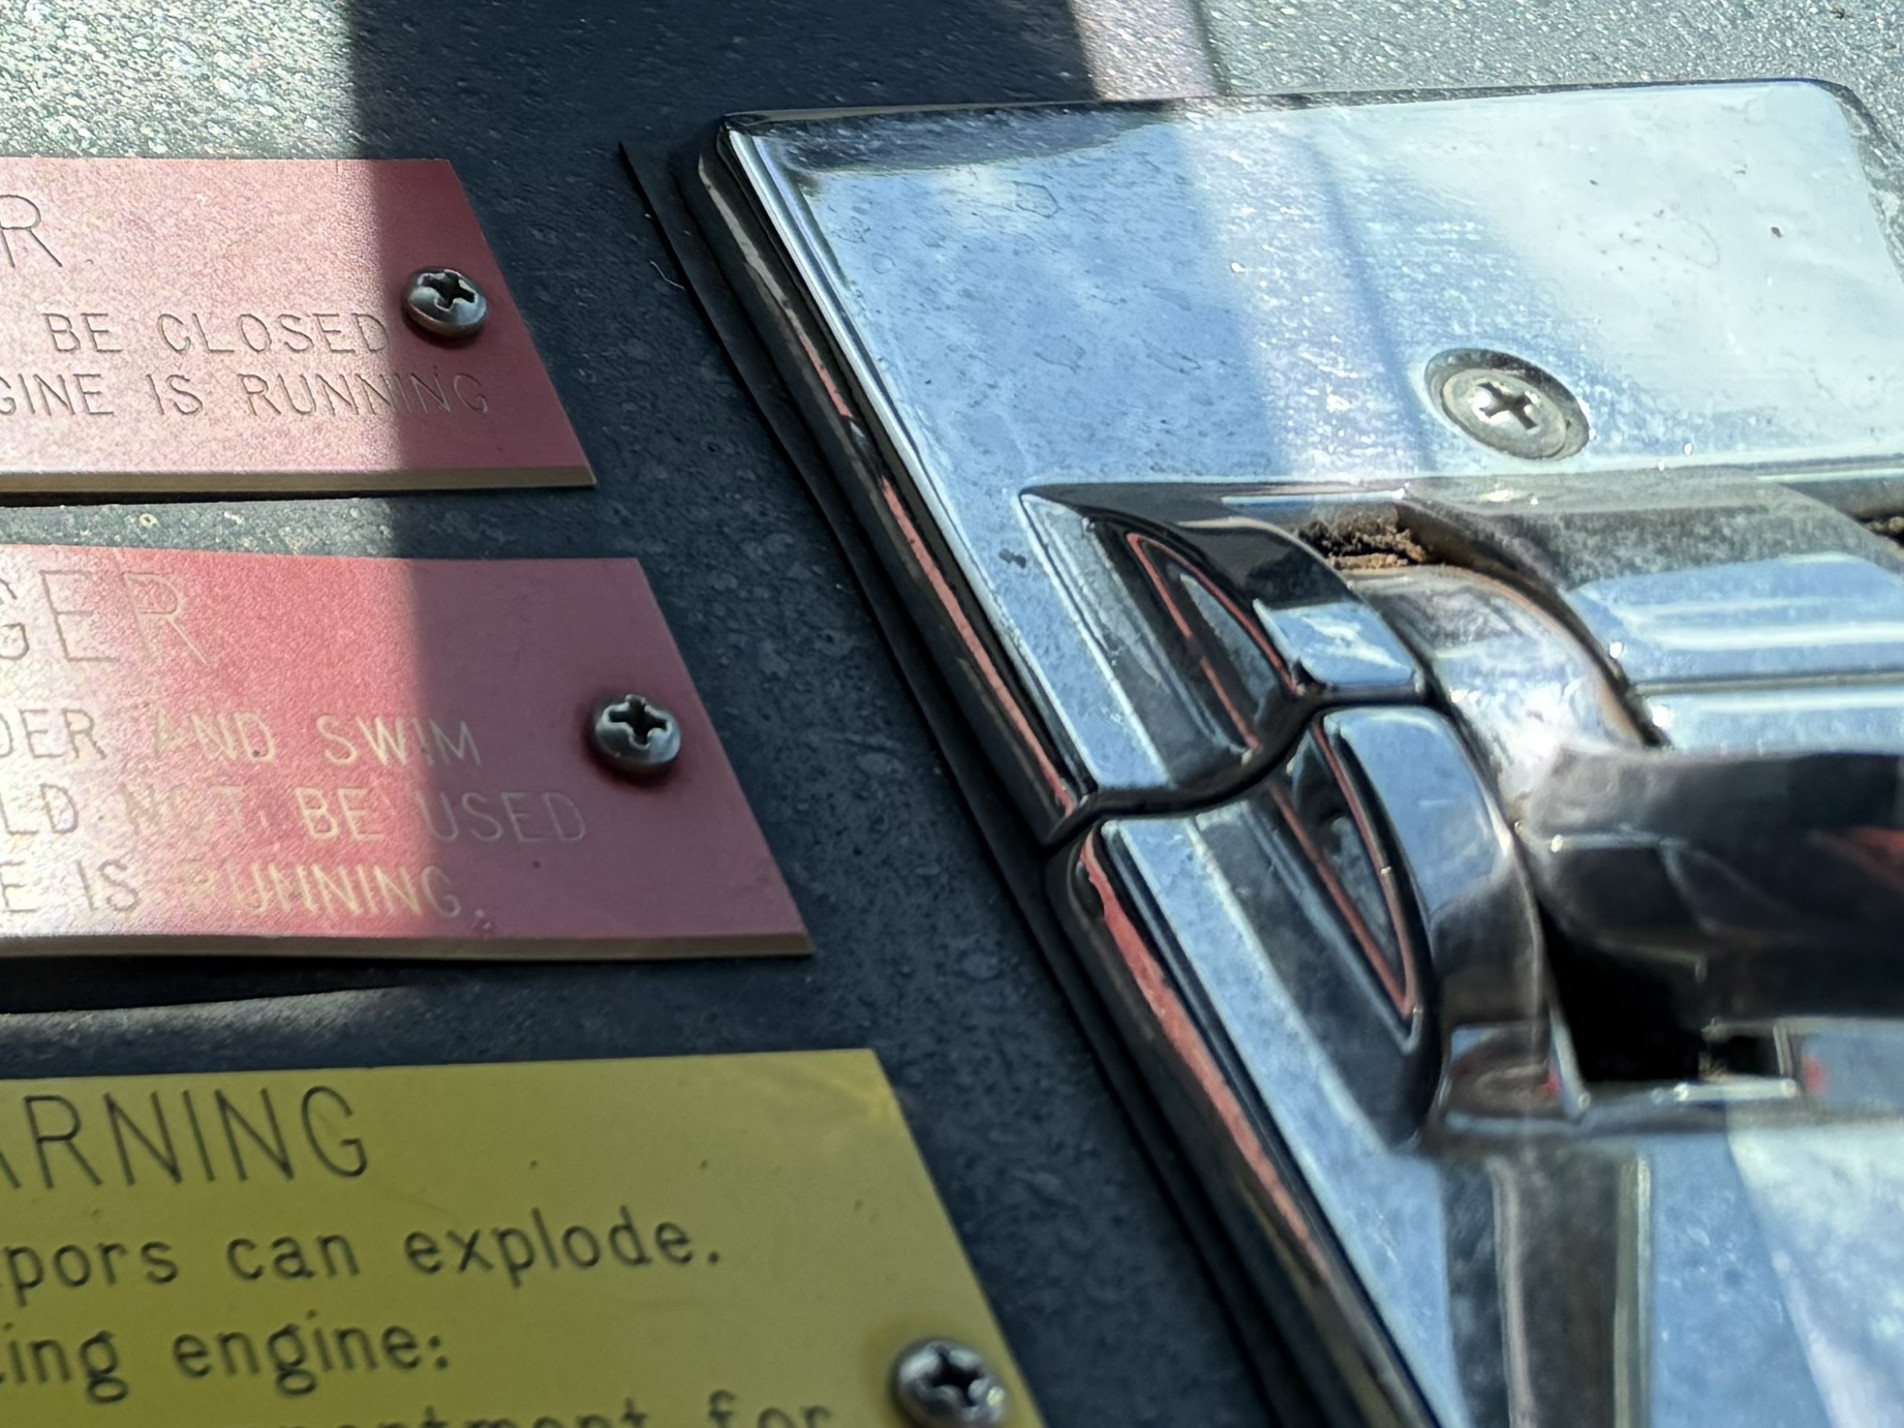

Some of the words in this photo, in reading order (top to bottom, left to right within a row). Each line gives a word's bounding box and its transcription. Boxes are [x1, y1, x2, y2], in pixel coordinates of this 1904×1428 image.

[46, 311, 123, 355] BE
[159, 311, 389, 356] CLOSED
[147, 373, 204, 417] IS
[240, 372, 489, 416] RUNNING
[152, 710, 275, 764] AND
[316, 713, 482, 768] SWIM
[296, 786, 383, 844] BE
[414, 790, 586, 842] USED
[80, 860, 139, 911] IS
[226, 1231, 360, 1282] can
[404, 1205, 720, 1290] explode.
[171, 1310, 449, 1397] engine:
